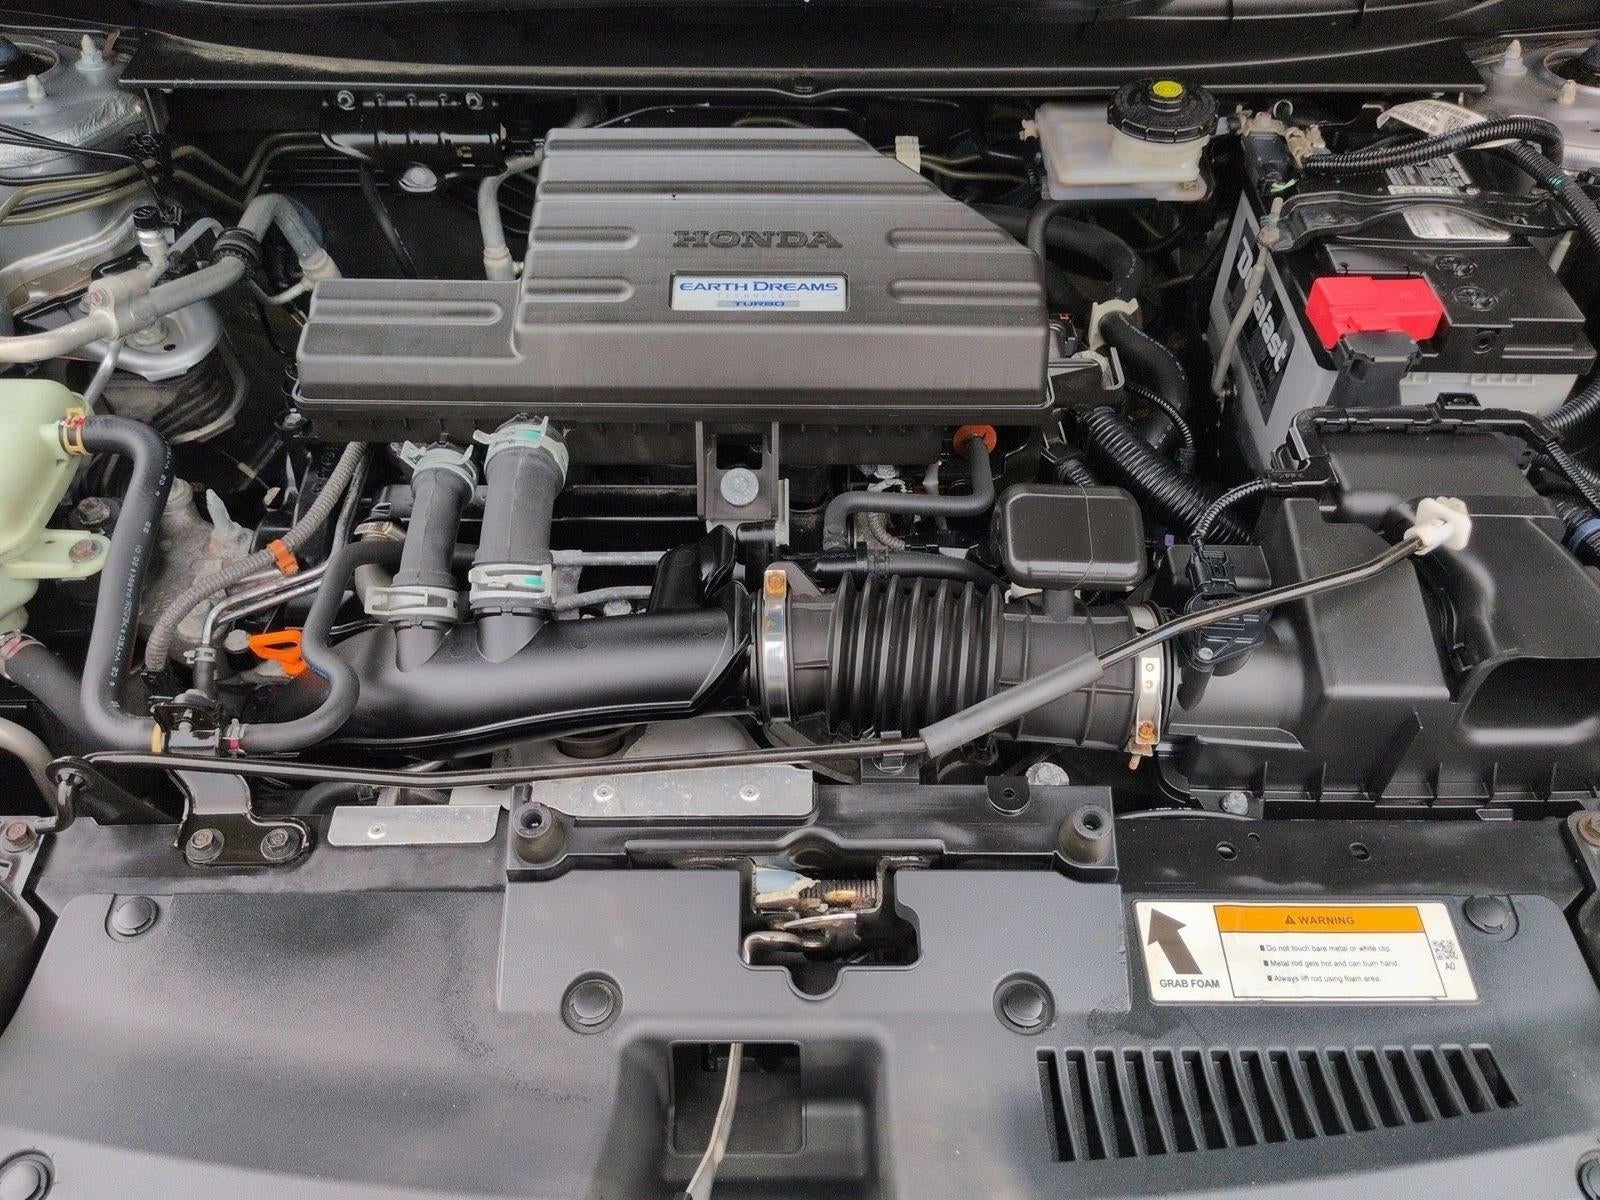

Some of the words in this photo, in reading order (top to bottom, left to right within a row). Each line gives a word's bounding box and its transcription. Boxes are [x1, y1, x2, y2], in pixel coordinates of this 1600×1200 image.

[673, 230, 843, 248] HONDA
[680, 282, 748, 292] EARTH
[753, 281, 838, 292] DREAMS
[1237, 236, 1288, 373] Dualast
[1299, 916, 1355, 925] WARNING
[1266, 944, 1276, 952] Do
[1278, 944, 1289, 952] not
[1291, 944, 1310, 952] touch
[1312, 944, 1327, 952] bare
[1329, 944, 1348, 952] metal
[1350, 944, 1357, 952] or
[1359, 944, 1377, 952] white
[1305, 960, 1319, 969] gets
[1160, 979, 1188, 988] GRAB
[1191, 979, 1220, 988] FOAM
[1274, 975, 1299, 984] Always
[1324, 975, 1343, 984] using
